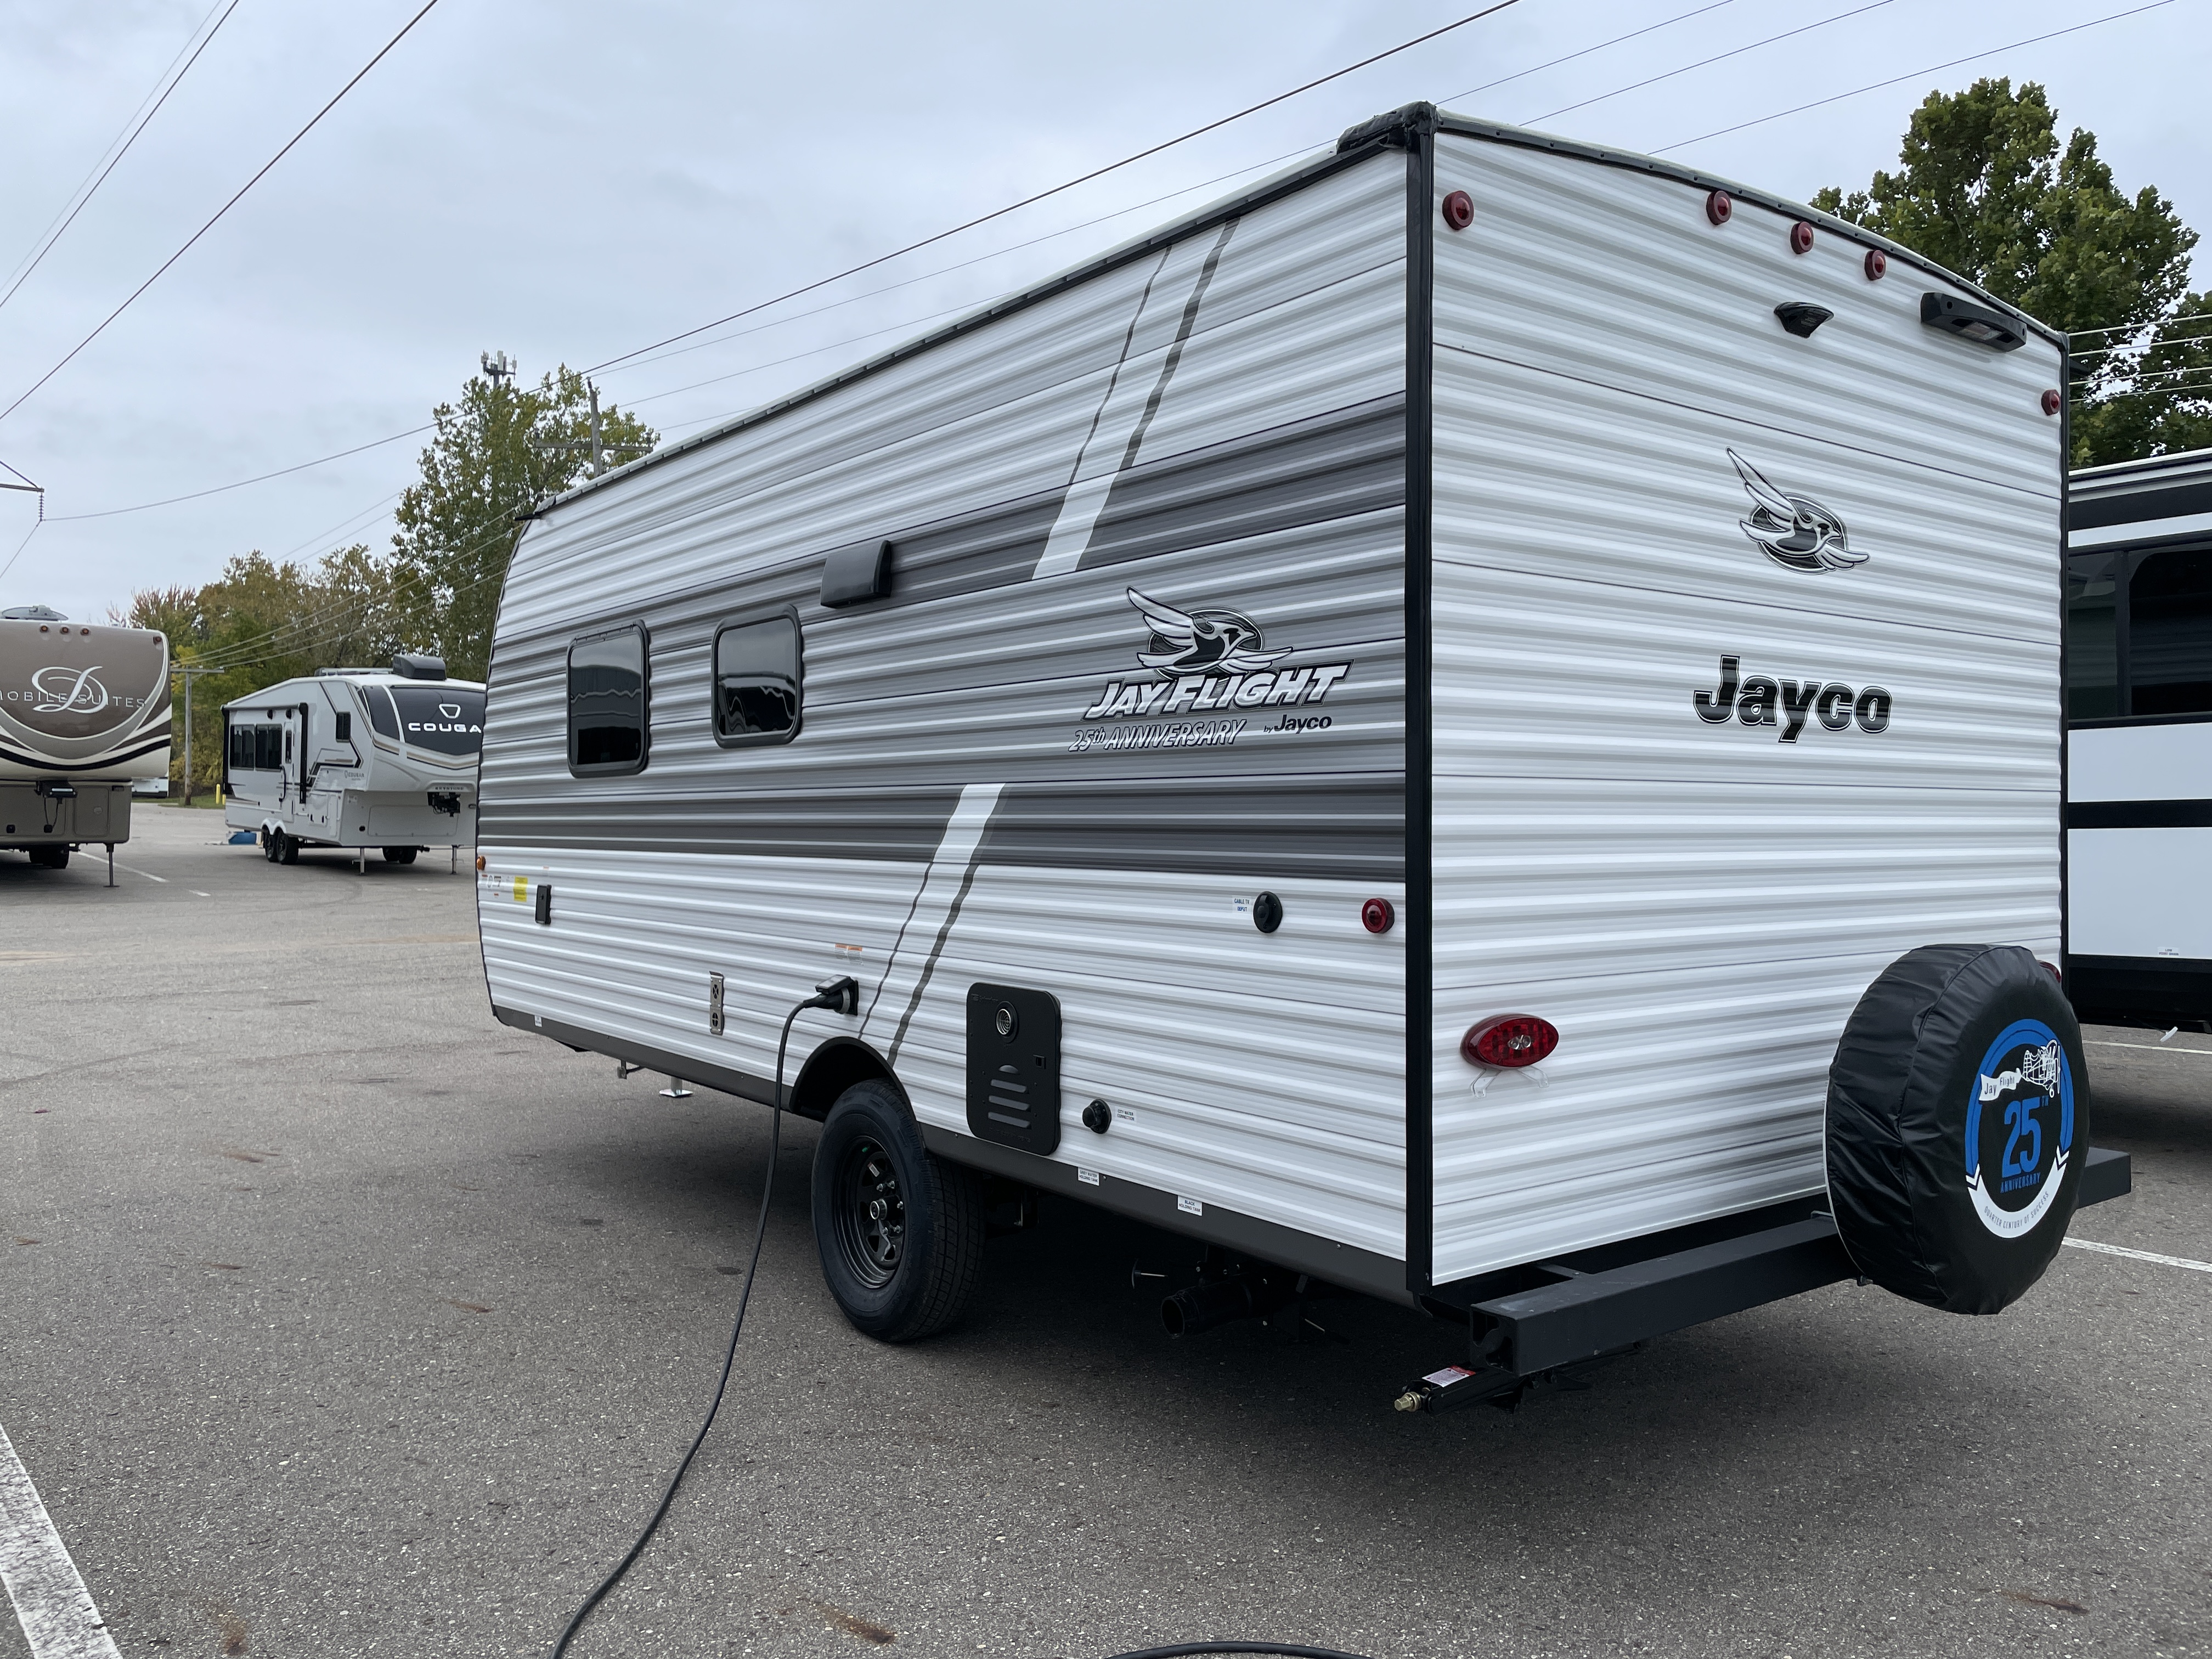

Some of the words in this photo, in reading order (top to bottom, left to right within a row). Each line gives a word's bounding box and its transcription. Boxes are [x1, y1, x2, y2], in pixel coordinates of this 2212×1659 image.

[1082, 676, 1172, 722] JAY
[1158, 659, 1355, 716] FLIGHT
[1693, 654, 1893, 743] Jayco
[408, 723, 482, 733] COUGA
[1068, 727, 1105, 752] 25th
[1104, 719, 1247, 749] ANNIVERSARY
[1273, 714, 1332, 734] Jayco
[1984, 1082, 1997, 1096] Jay
[2000, 1075, 2015, 1087] Flight
[2000, 1172, 2040, 1194] ANNIVERSARY
[1984, 1206, 2002, 1227] QUARTER
[2003, 1219, 2022, 1229] CENTURY
[2024, 1215, 2029, 1224] OF
[2031, 1191, 2049, 1218] SUCCESS
